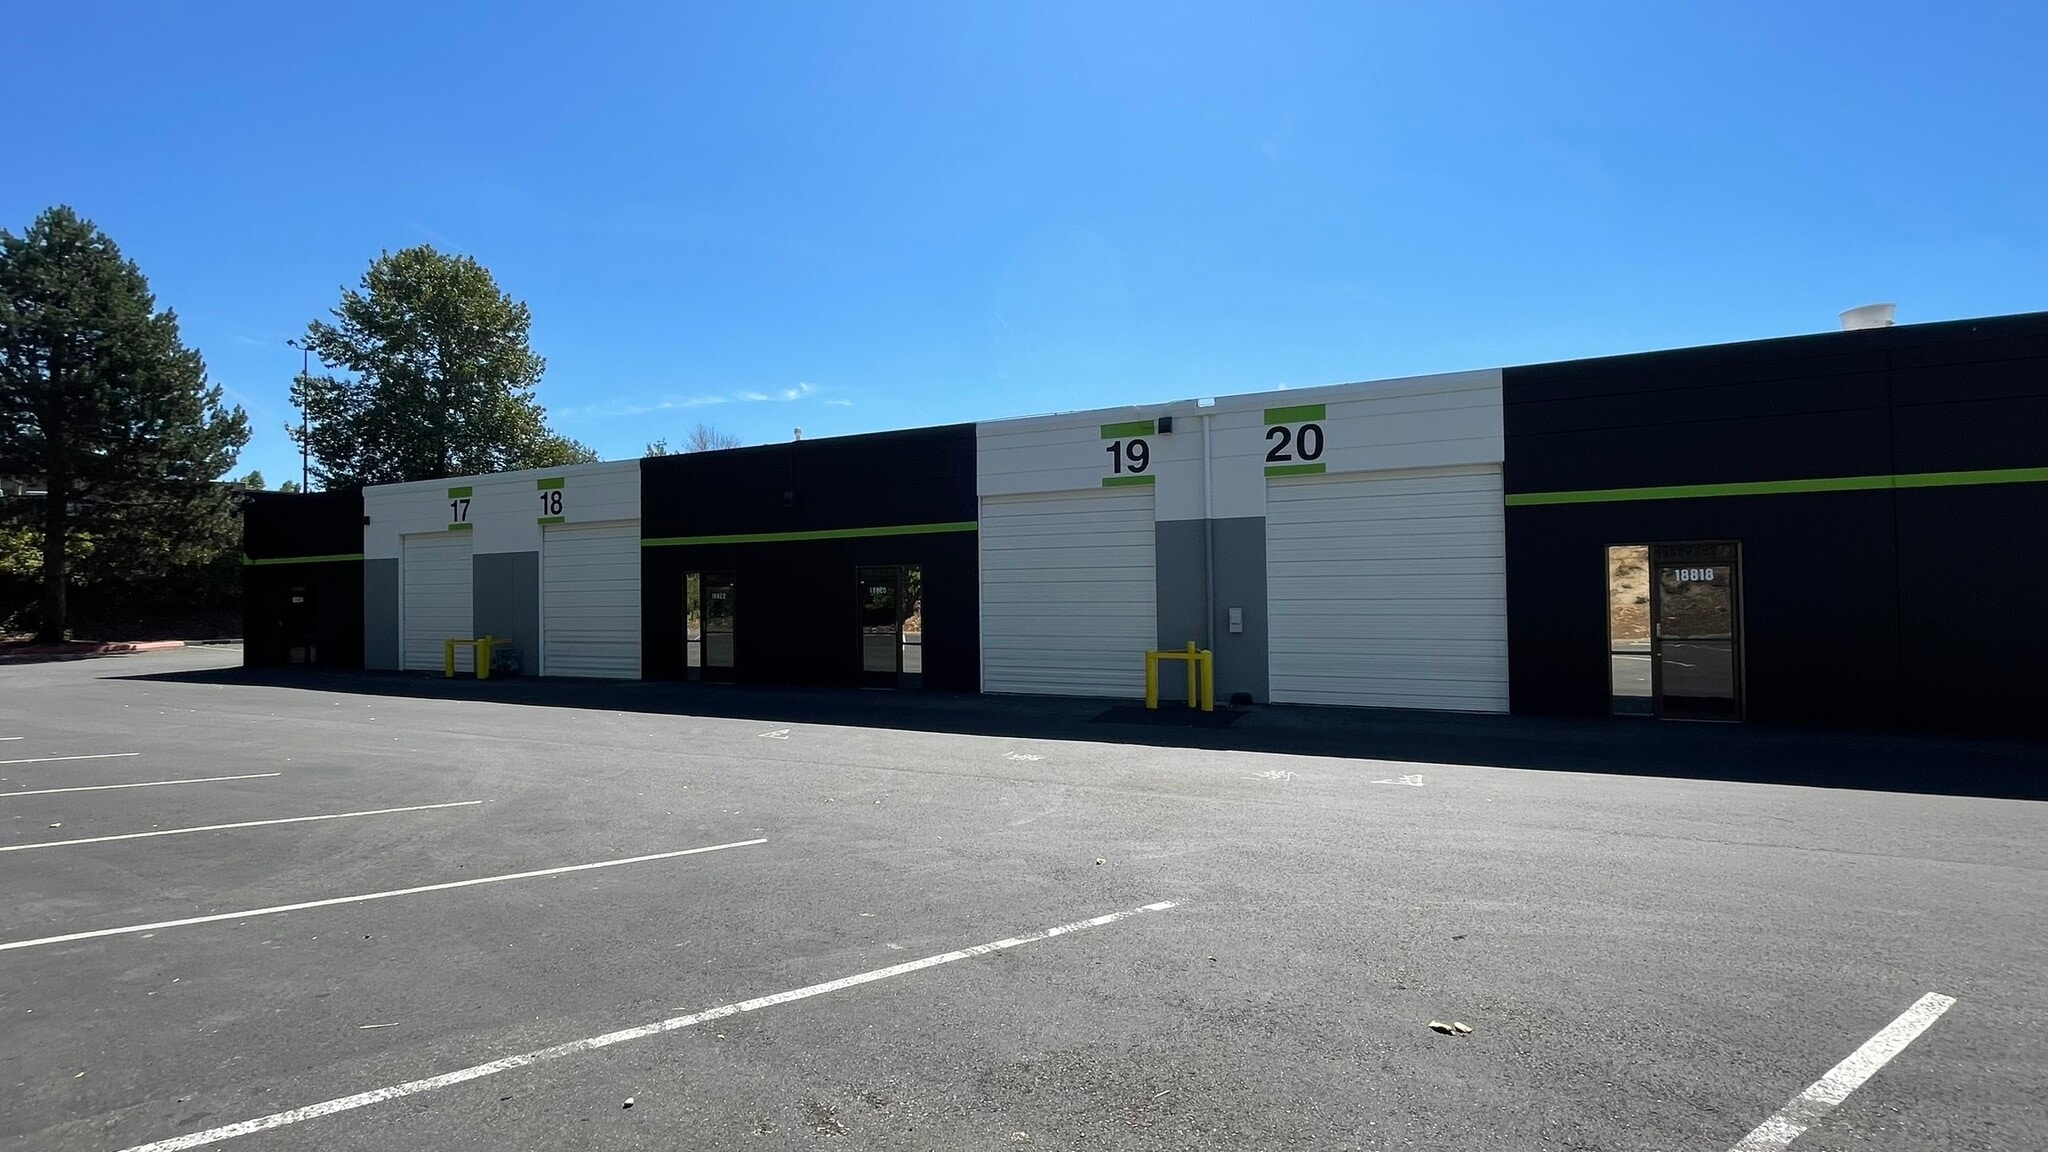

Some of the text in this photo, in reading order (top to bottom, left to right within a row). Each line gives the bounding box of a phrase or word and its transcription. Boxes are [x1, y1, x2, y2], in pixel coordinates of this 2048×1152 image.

[1265, 424, 1324, 462] 20
[1106, 439, 1149, 474] 19
[450, 499, 471, 522] 17
[540, 490, 563, 515] 18
[1674, 568, 1714, 582] 18818
